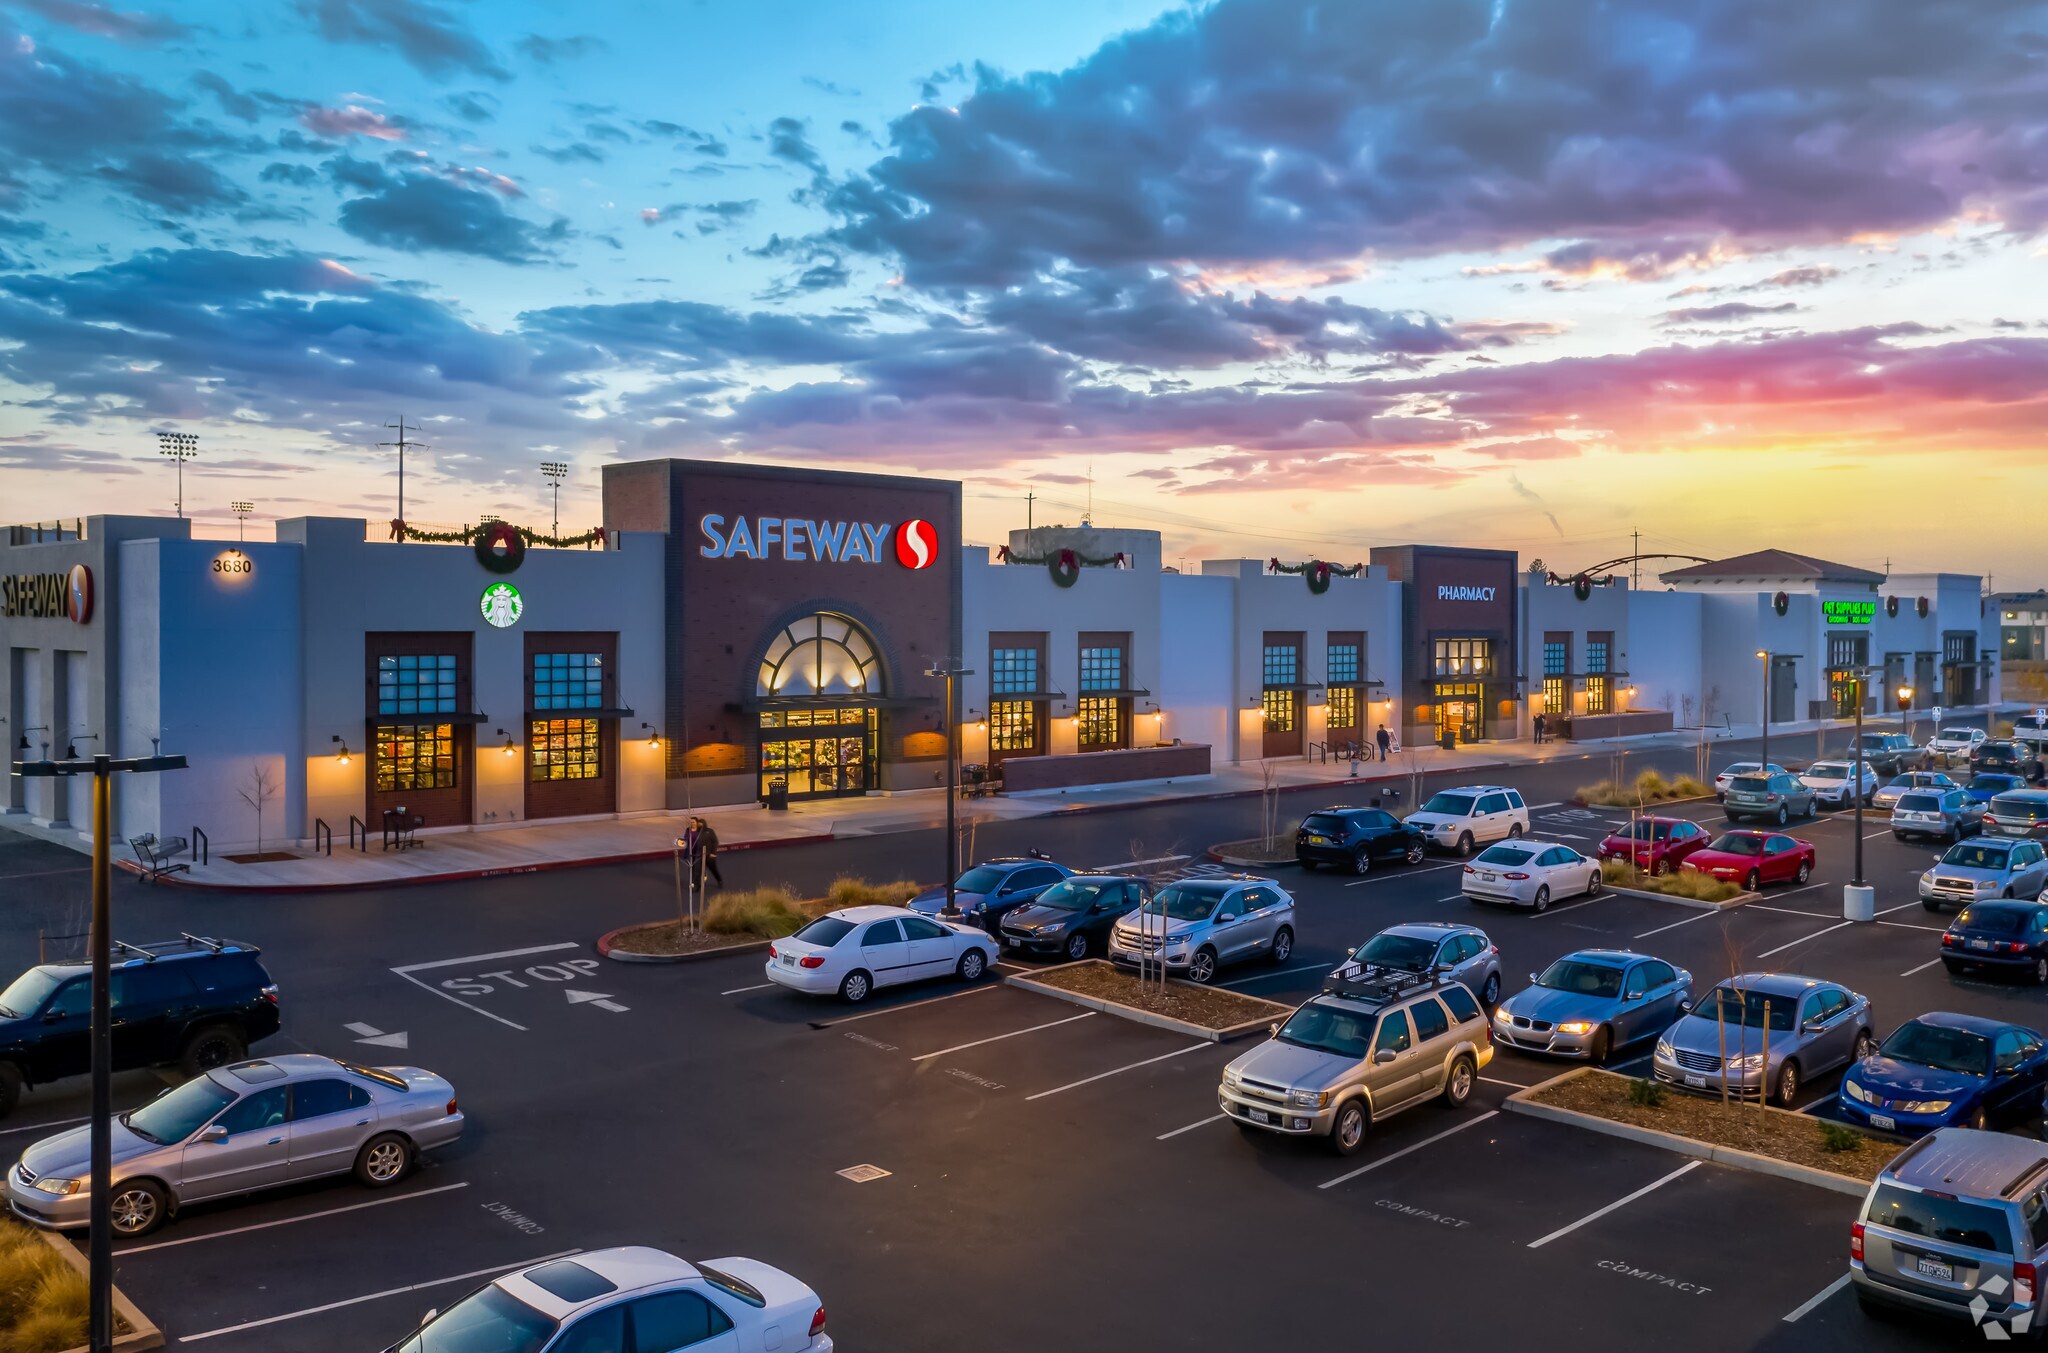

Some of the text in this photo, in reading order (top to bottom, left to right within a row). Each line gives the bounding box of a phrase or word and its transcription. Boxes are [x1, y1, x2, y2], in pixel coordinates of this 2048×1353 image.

[701, 514, 891, 562] SAFEWAY
[213, 559, 252, 573] 3680
[1, 574, 69, 617] SAFEWAY
[1437, 585, 1496, 602] PHARMACY
[1822, 601, 1875, 615] PET SUPPLIES PLUS
[441, 959, 600, 996] STOP
[844, 1031, 900, 1052] COMPACT
[945, 1068, 1006, 1091] COMPACT
[481, 1201, 545, 1235] COMPACT
[1375, 1199, 1470, 1228] COMPACT
[1597, 1260, 1712, 1295] COMPACT
